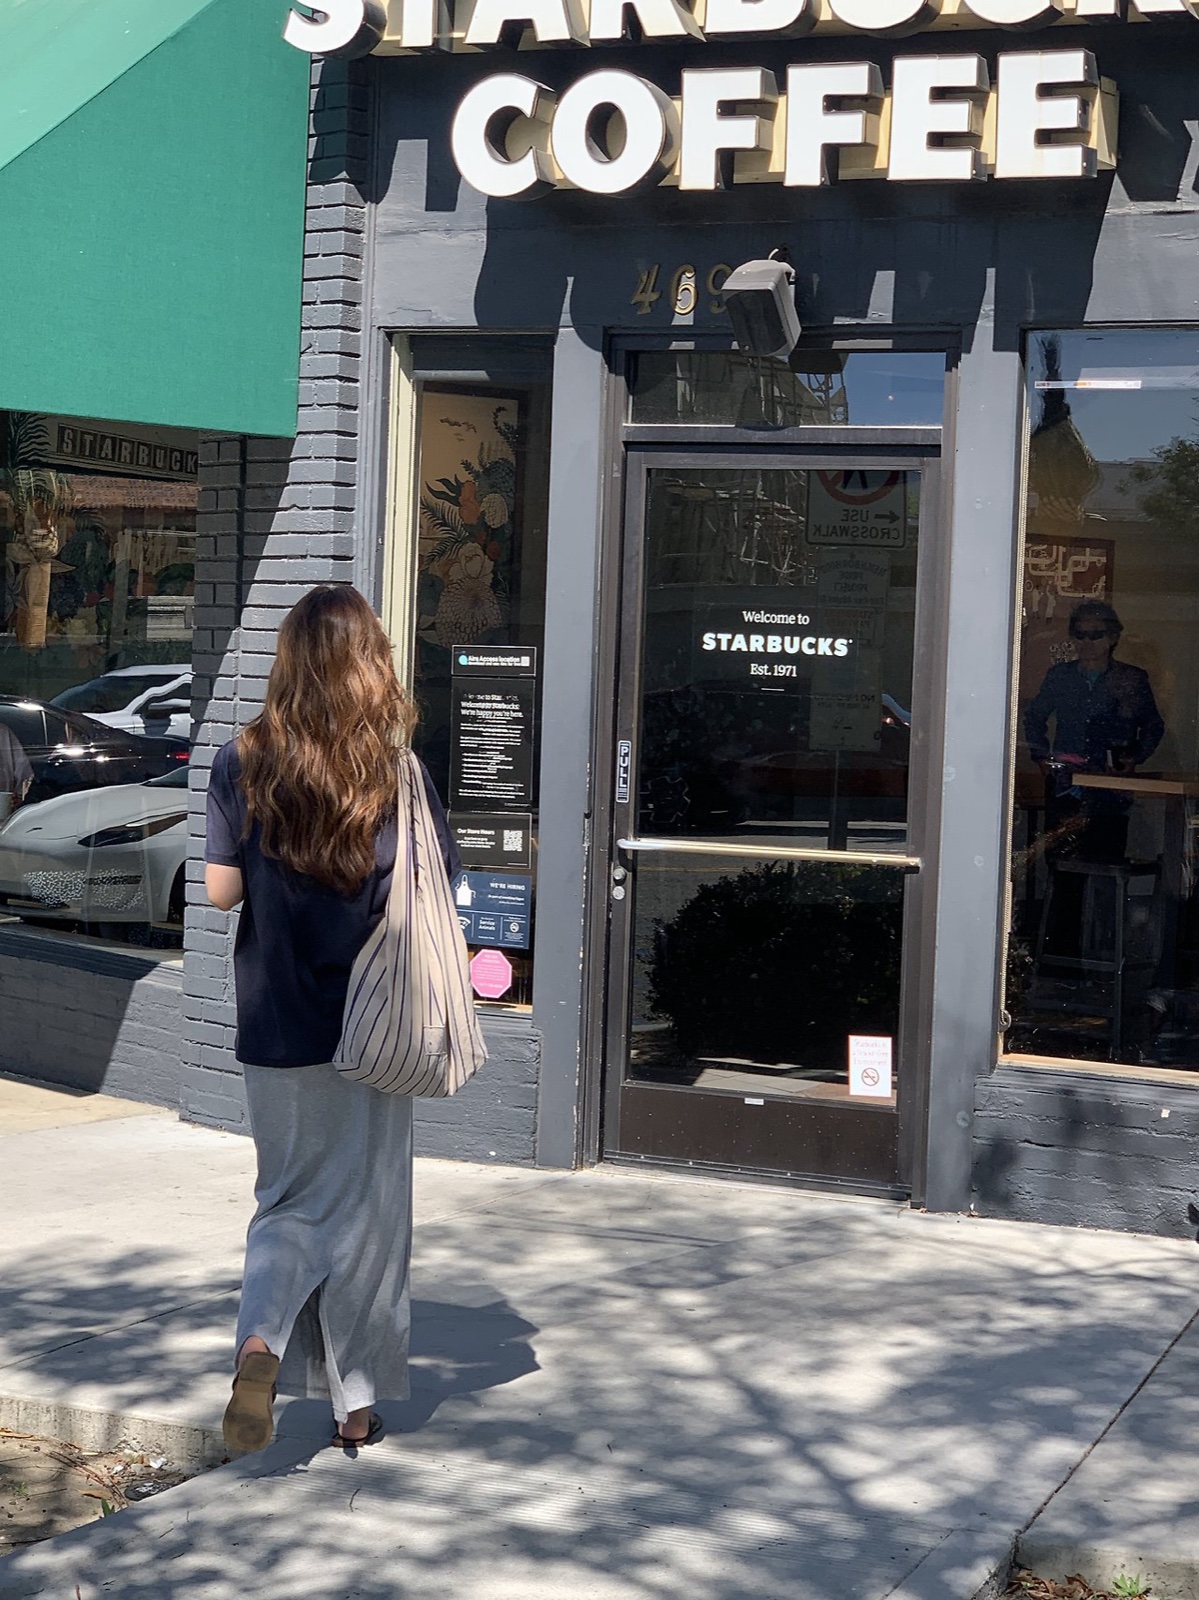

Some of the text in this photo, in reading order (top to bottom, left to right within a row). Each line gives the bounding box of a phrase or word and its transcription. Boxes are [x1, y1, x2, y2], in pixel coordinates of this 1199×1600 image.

[451, 49, 1096, 198] COFFEE
[742, 610, 810, 625] Welcome to
[702, 632, 849, 657] STARBUCKS
[750, 663, 798, 677] Est. 1971
[619, 746, 630, 788] PULL
